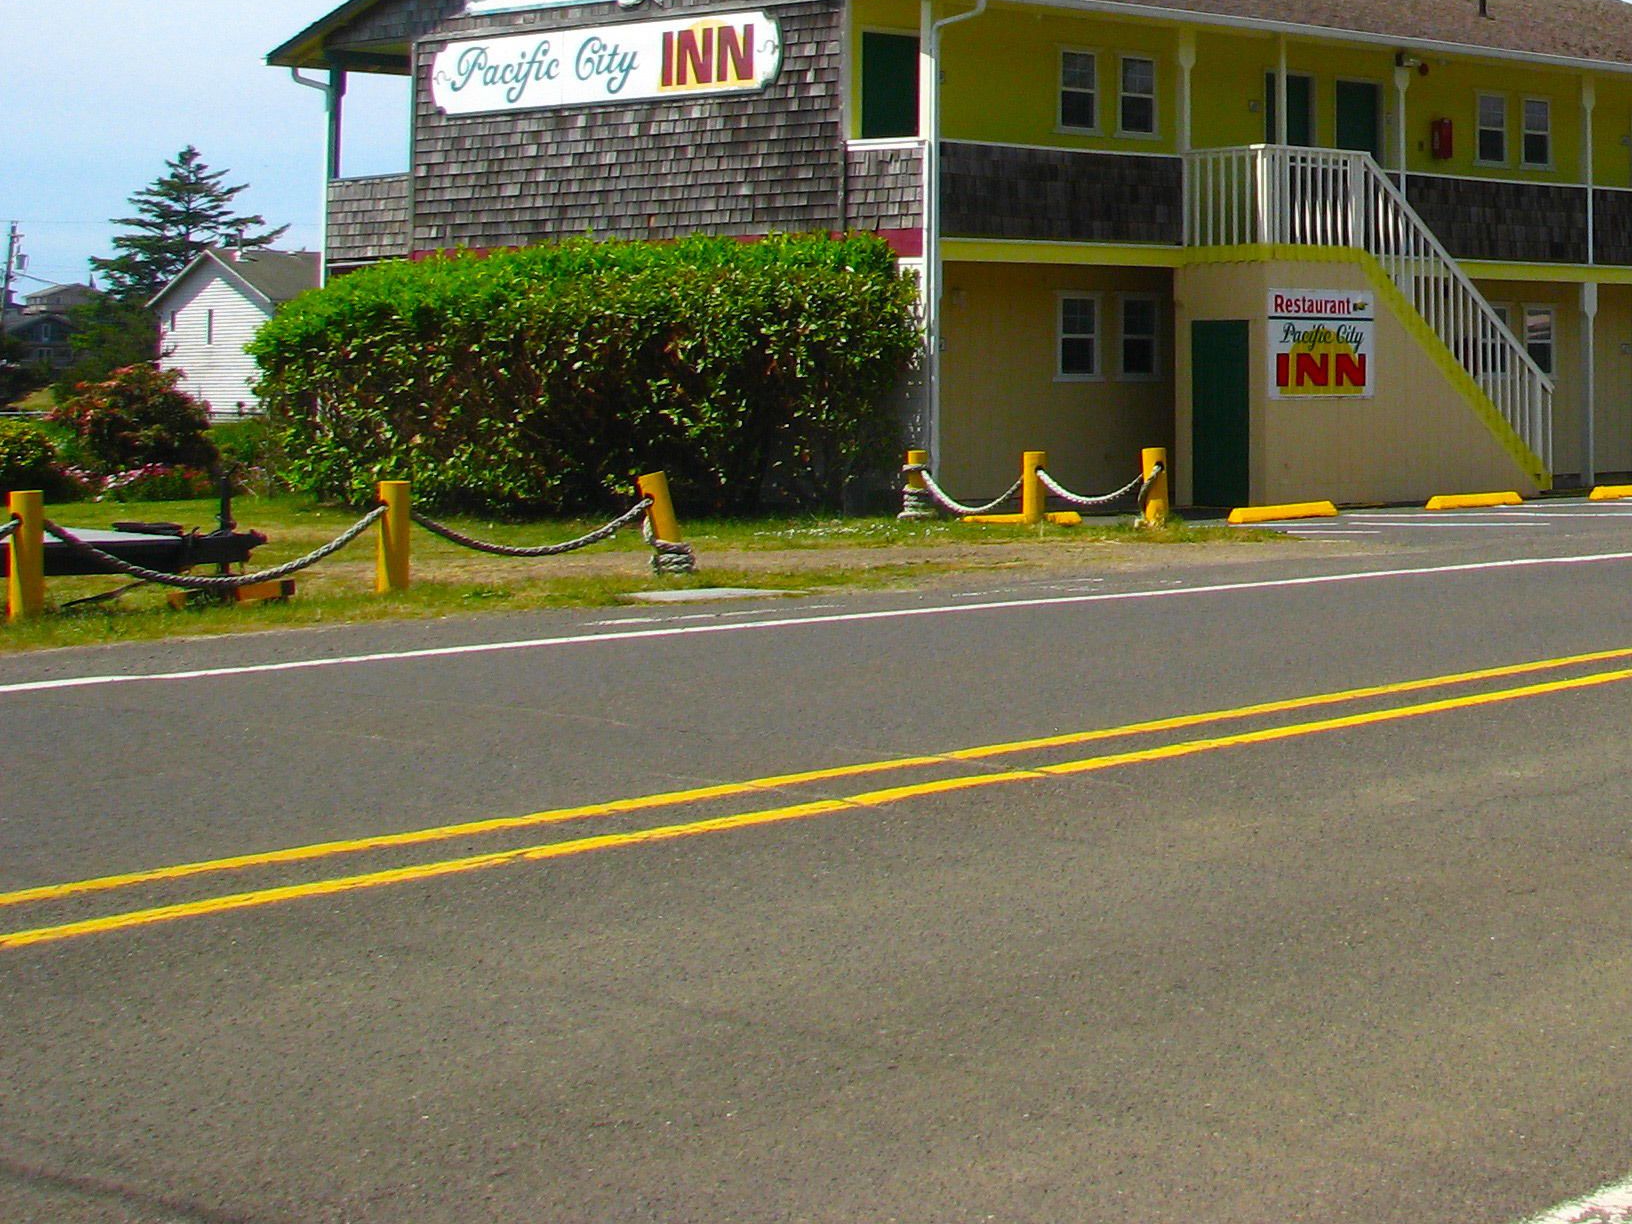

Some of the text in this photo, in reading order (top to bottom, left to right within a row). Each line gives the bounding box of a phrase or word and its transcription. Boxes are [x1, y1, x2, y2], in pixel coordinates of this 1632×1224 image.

[451, 23, 755, 103] Pacific City INN
[1274, 294, 1352, 314] Restaurant
[1280, 322, 1364, 353] Pacific City
[1276, 353, 1367, 387] INN
